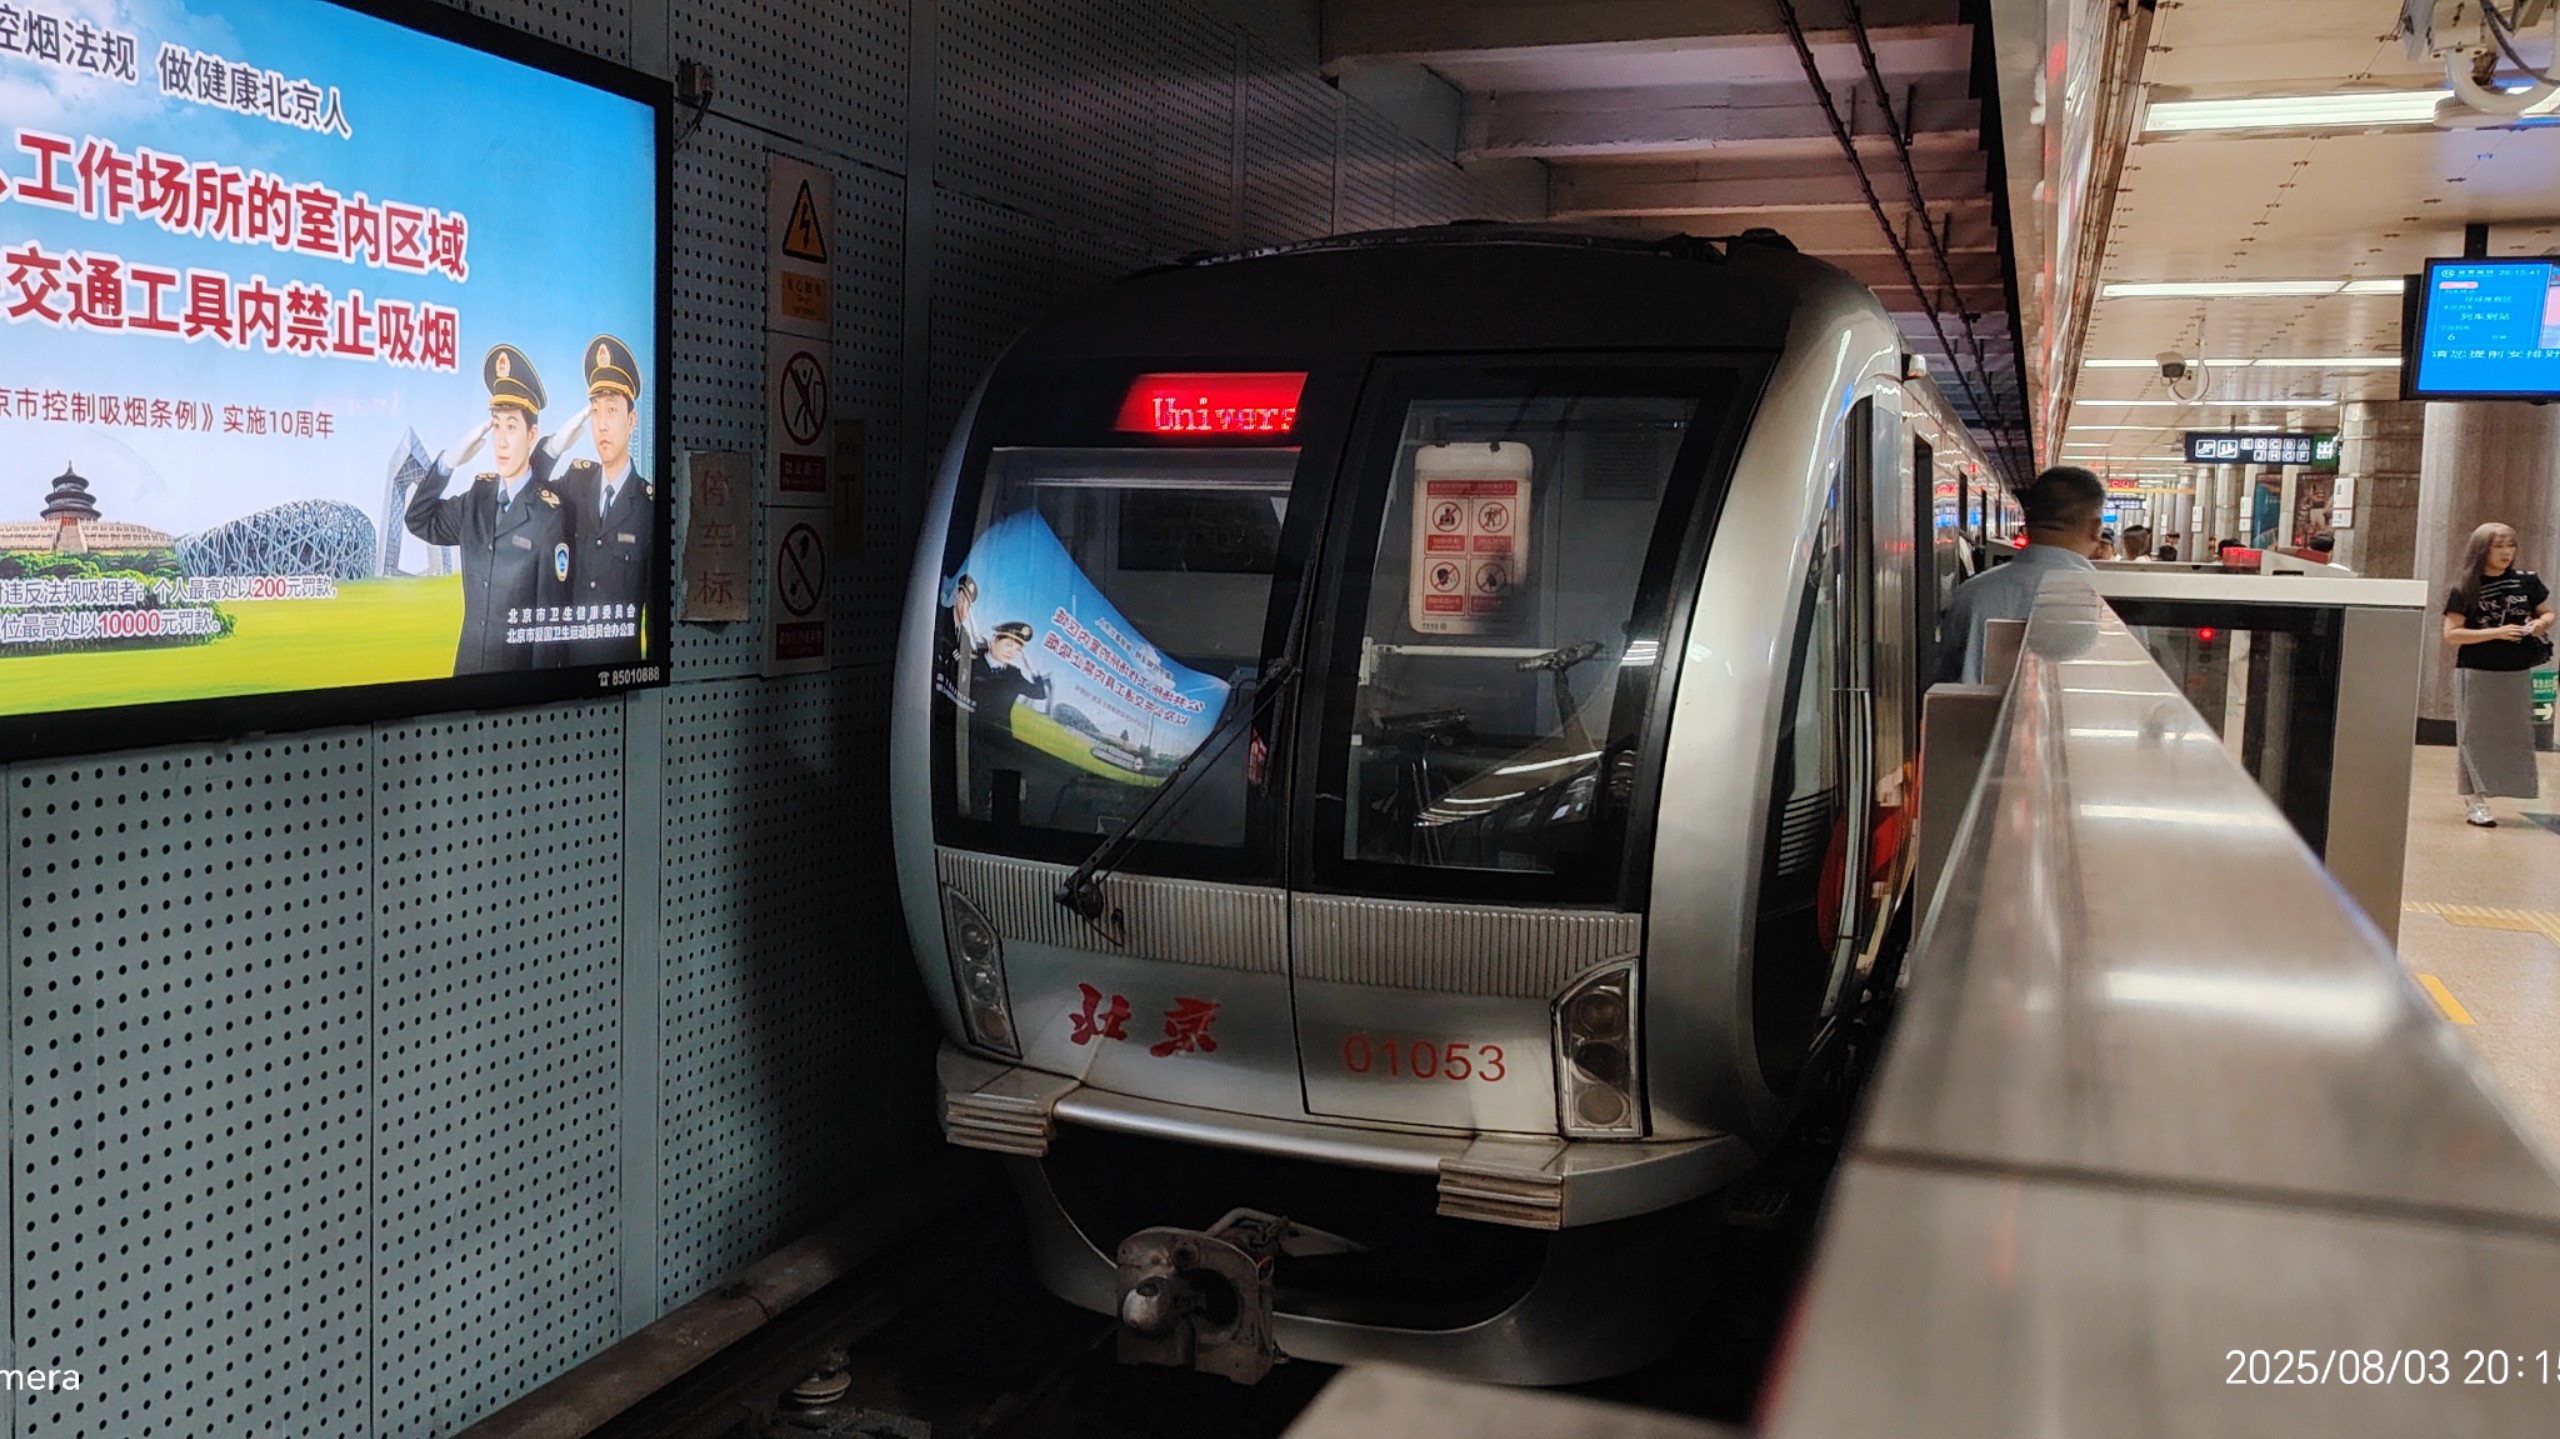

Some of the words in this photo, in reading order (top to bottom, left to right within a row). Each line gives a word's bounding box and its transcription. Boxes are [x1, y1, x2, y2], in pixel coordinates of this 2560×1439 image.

[159, 46, 350, 134] 做健康北京人
[6, 246, 457, 369] 交通工具内禁止吸烟
[2447, 333, 2456, 341] 6
[695, 470, 735, 605] 停车标
[0, 579, 337, 606] 违反法规吸烟者：个人最高处以200元罚款，
[507, 603, 636, 624] 北京市卫生健康委员会
[612, 666, 660, 686] 85010888
[1070, 982, 1221, 1057] 北京
[1343, 1033, 1507, 1082] 01053
